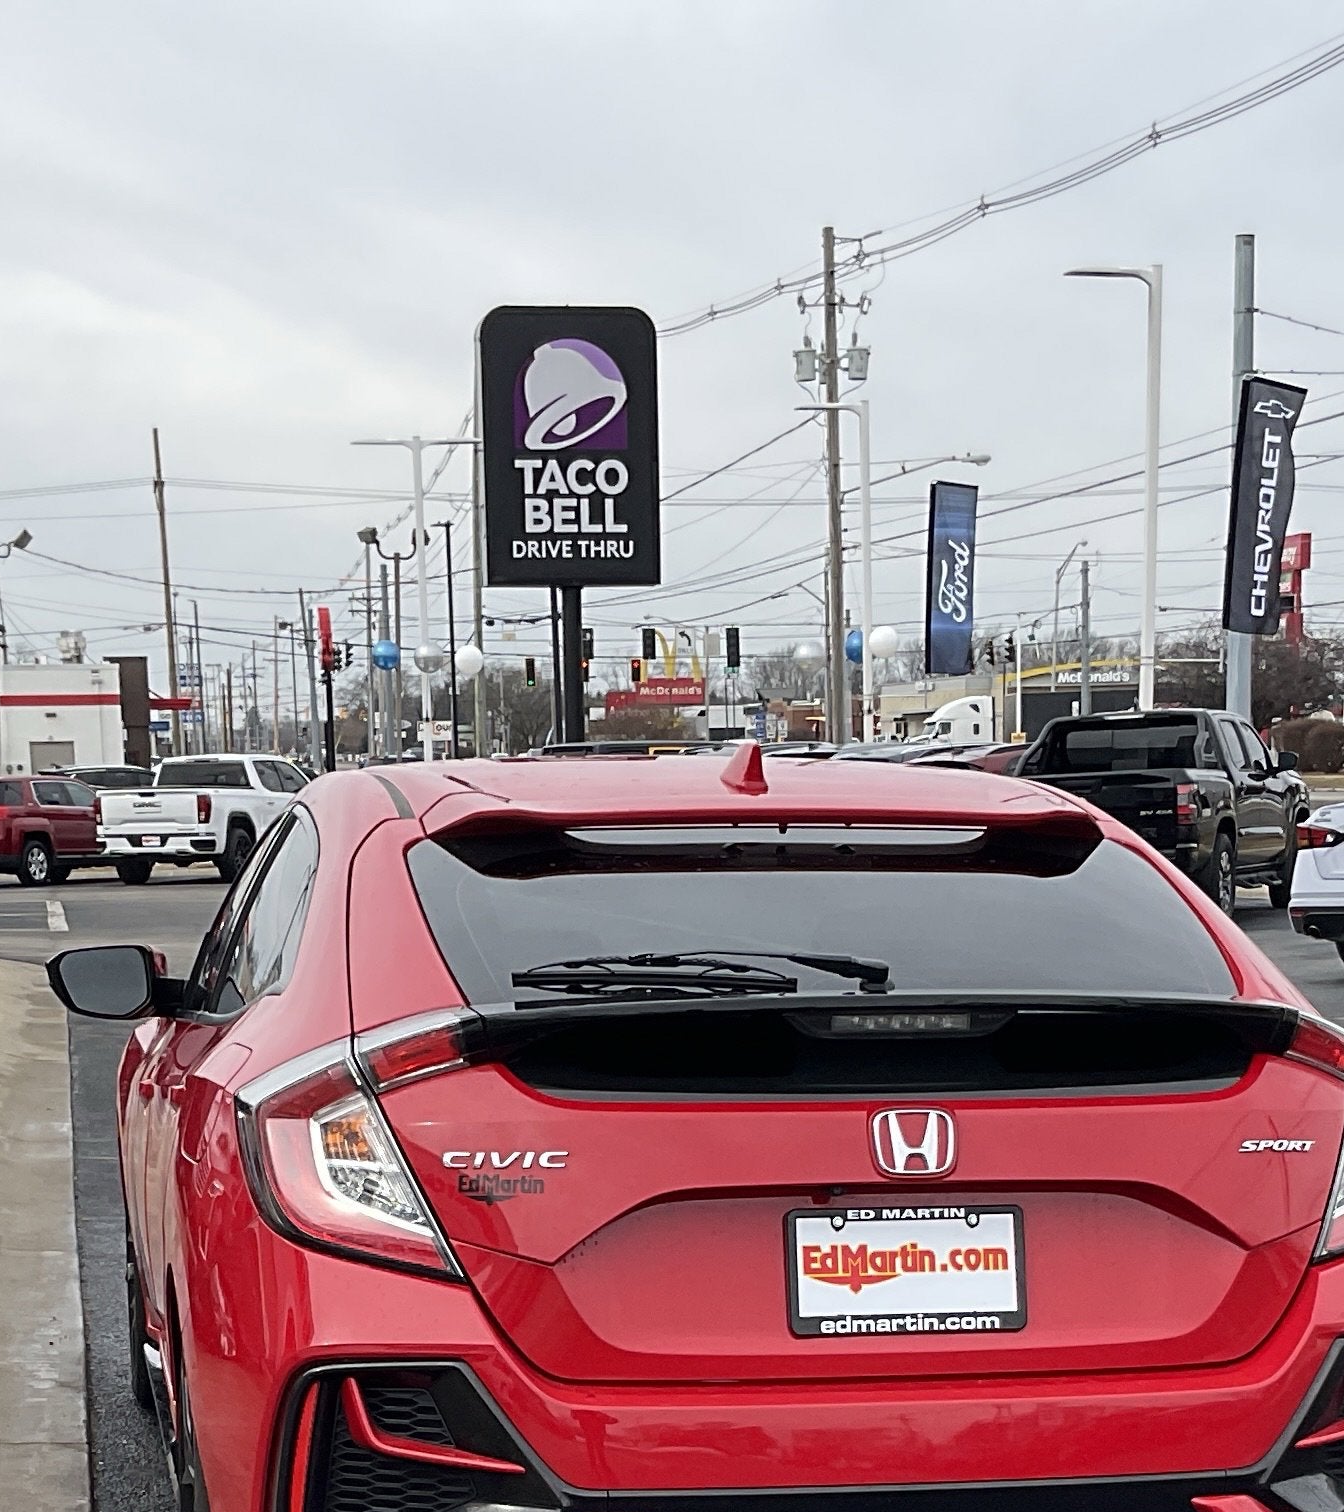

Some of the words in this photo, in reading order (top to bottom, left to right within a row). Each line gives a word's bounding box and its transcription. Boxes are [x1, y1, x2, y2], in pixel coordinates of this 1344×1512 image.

[514, 459, 629, 495] TACO
[524, 497, 628, 533] BELL
[1250, 427, 1283, 617] CHEVROLET
[512, 540, 573, 558] DRIVE
[577, 540, 634, 558] THRU
[938, 539, 971, 623] Ford
[1057, 671, 1130, 683] McDonald's
[639, 686, 702, 696] McDonald's
[1238, 1139, 1316, 1152] SPORT
[442, 1151, 569, 1169] CIVIC
[846, 1209, 875, 1220] ED
[882, 1207, 966, 1219] MARTIN
[820, 1313, 1000, 1334] edmartin.com
